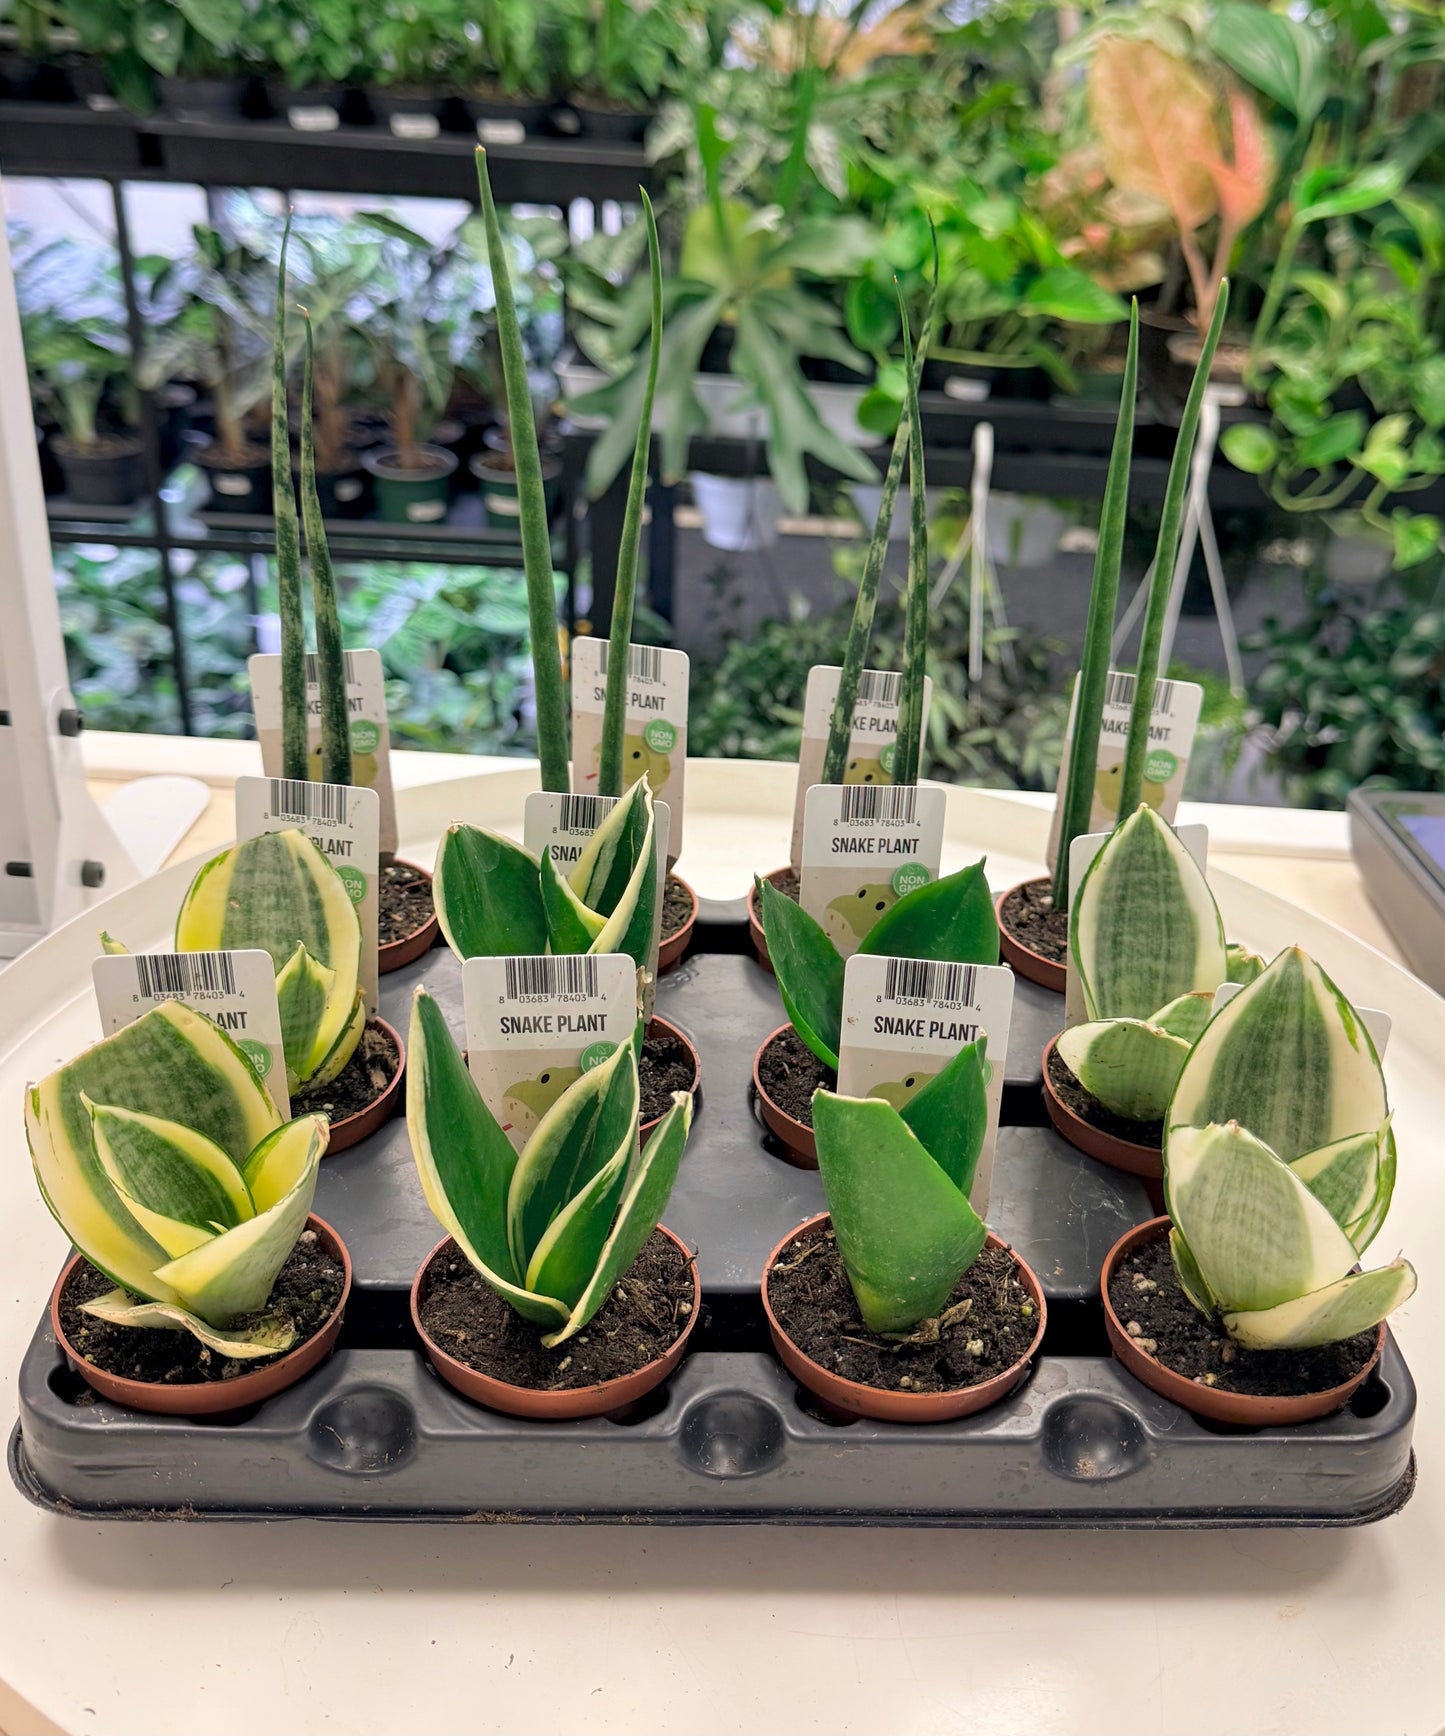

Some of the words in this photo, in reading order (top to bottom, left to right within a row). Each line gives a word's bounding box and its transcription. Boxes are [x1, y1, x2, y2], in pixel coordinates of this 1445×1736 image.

[631, 692, 666, 711] PLANT
[869, 717, 898, 733] PLAN
[1101, 719, 1129, 735] NAKE
[1148, 725, 1171, 741] ANT
[651, 730, 673, 740] NON
[280, 814, 306, 824] 03683
[312, 818, 337, 828] 78403
[849, 819, 874, 827] 03683
[552, 826, 558, 834] 8
[569, 828, 594, 837] 03683
[832, 837, 875, 853] SNAKE
[878, 838, 920, 854] PLANT
[551, 845, 582, 862] SNA
[345, 879, 362, 889] ON
[900, 875, 925, 884] NON
[133, 994, 139, 1002] 8
[193, 990, 225, 1000] 78403
[239, 990, 245, 998] 4
[499, 996, 505, 1004] 8
[519, 994, 549, 1003] 03683
[557, 993, 587, 1003] 78403
[876, 995, 882, 1003] 8
[896, 997, 925, 1007] 03683
[933, 1000, 962, 1010] 78403
[975, 1004, 981, 1012] 4
[217, 1011, 247, 1030] ANT
[500, 1015, 553, 1034] SNAKE
[557, 1014, 607, 1033] PLANT
[874, 1015, 926, 1038] SNAKE
[929, 1020, 979, 1042] PLANT
[589, 1056, 609, 1065] NO
